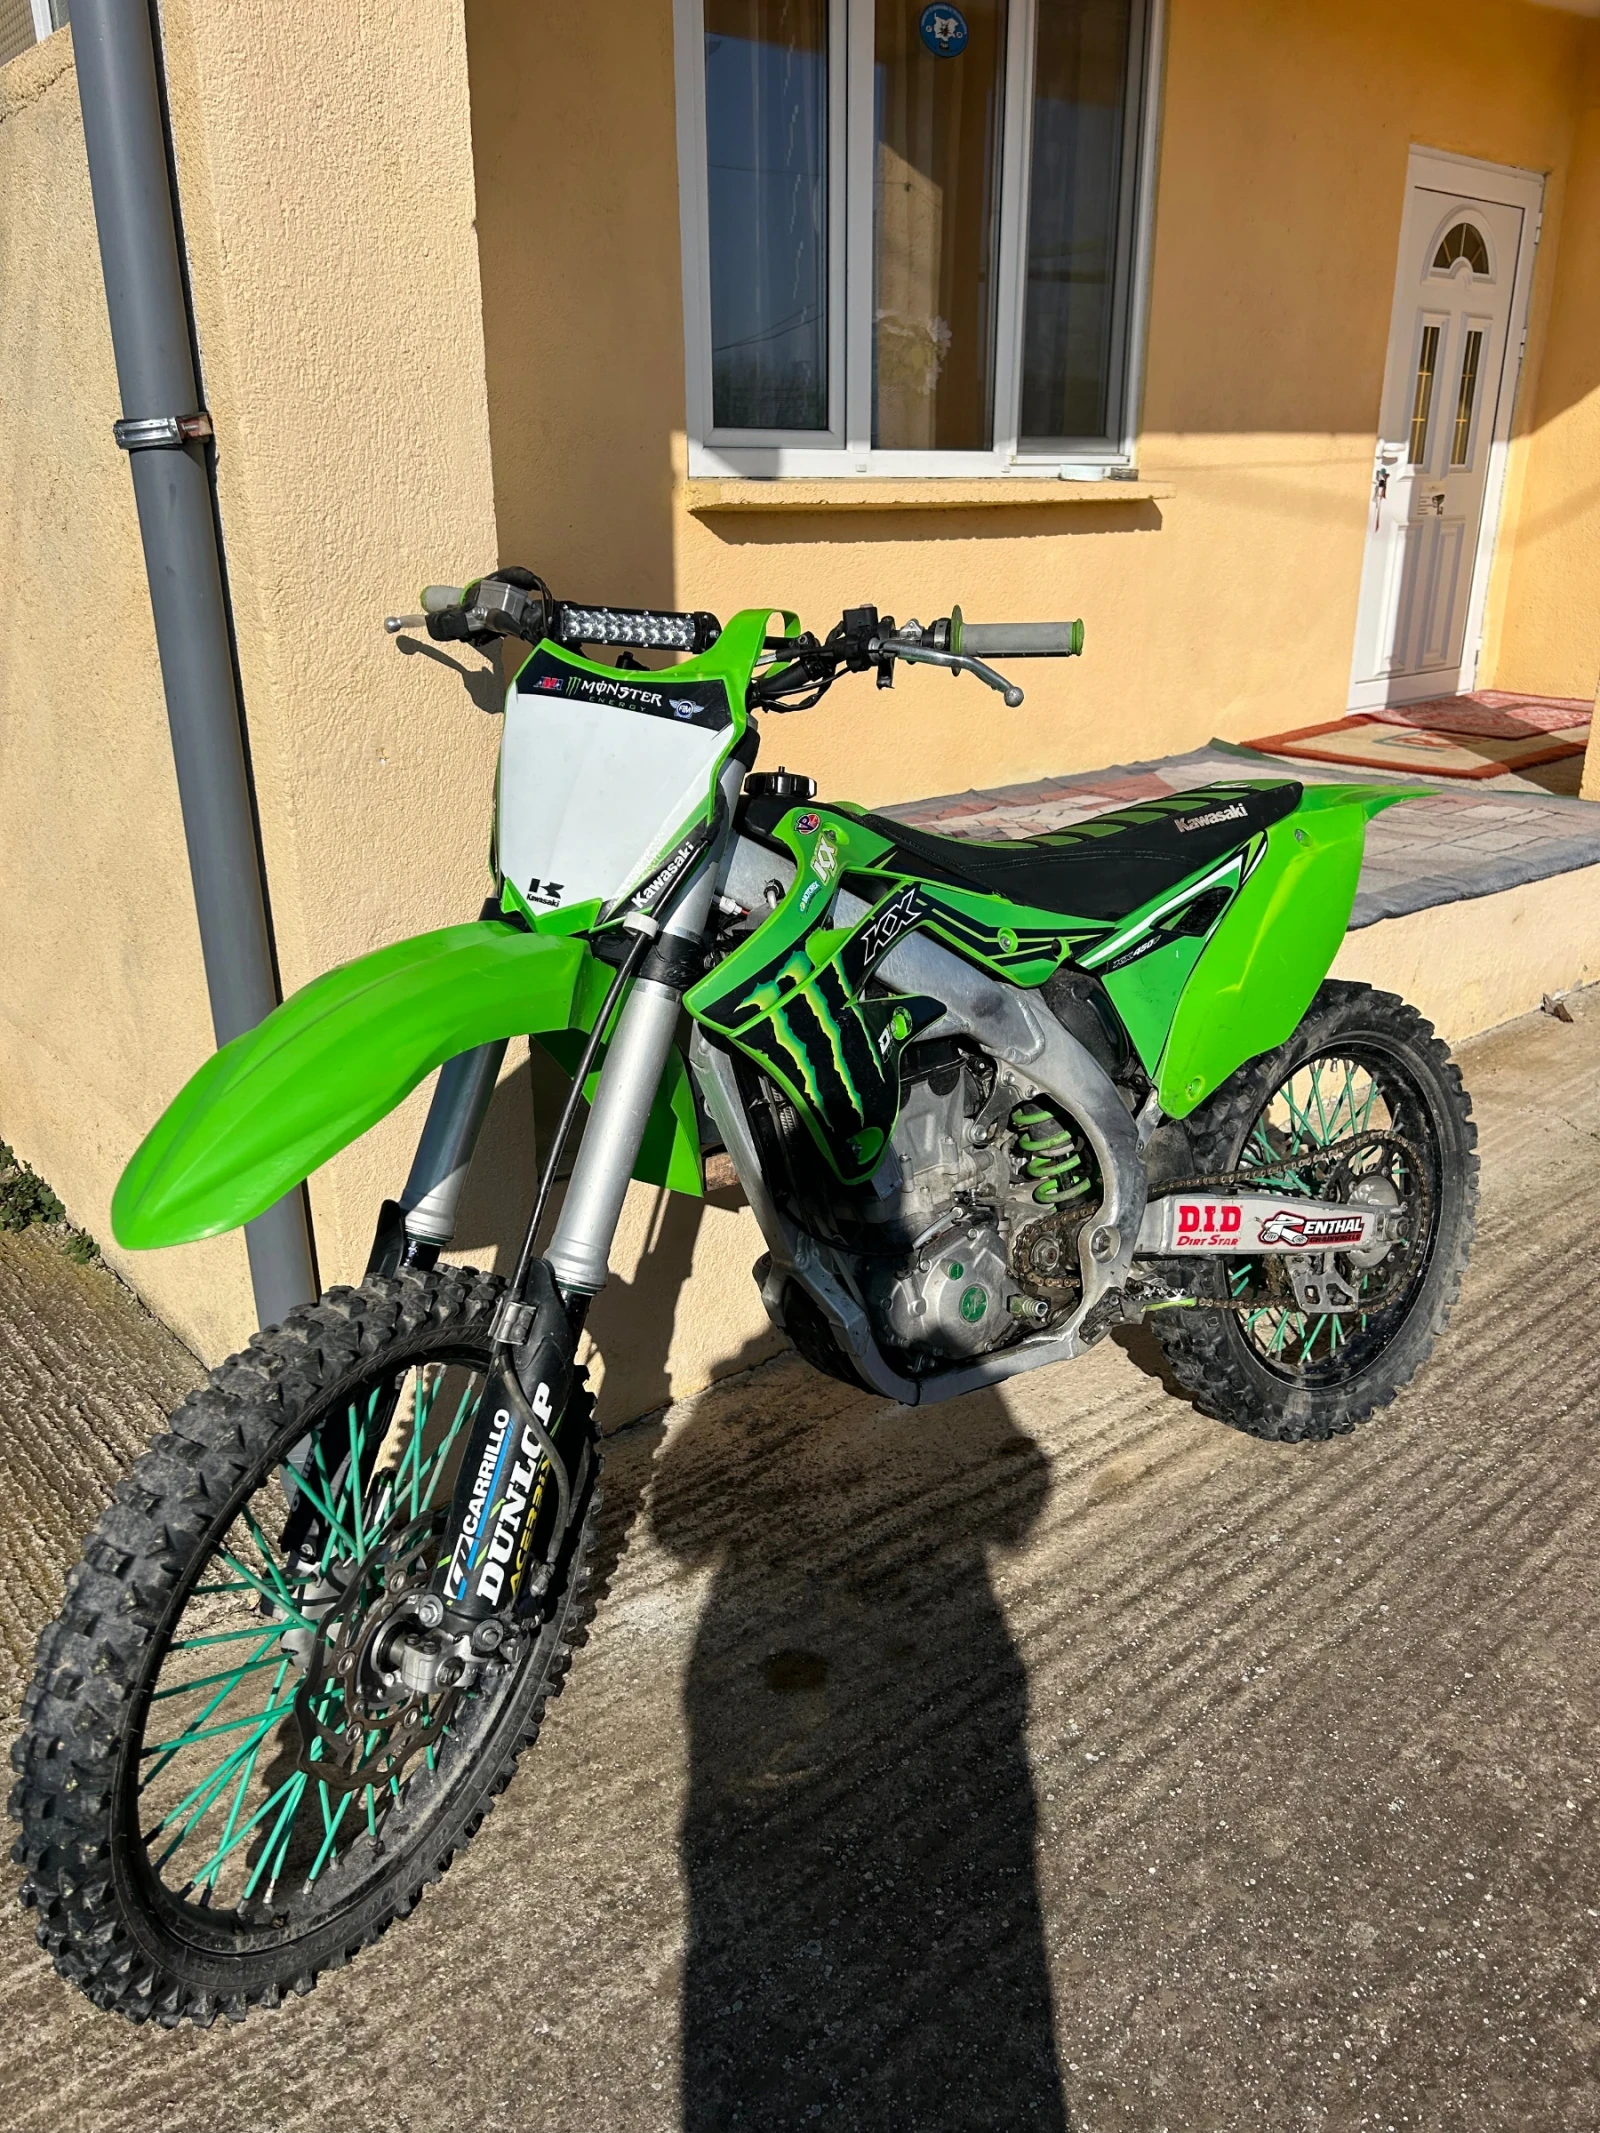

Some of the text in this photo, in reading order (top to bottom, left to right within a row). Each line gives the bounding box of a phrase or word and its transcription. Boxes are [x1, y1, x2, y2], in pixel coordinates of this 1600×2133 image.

[581, 680, 662, 707] MONSTER
[588, 696, 647, 712] ENERGY
[1173, 802, 1249, 833] Kawasaki
[631, 841, 695, 909] Kawasaki
[811, 834, 838, 885] KX
[526, 893, 561, 908] Kawasaki
[861, 887, 923, 967] KX
[1260, 1212, 1363, 1245] RENTHAL
[462, 1408, 510, 1535] CARRILLO
[476, 1381, 553, 1607] DUNLOP
